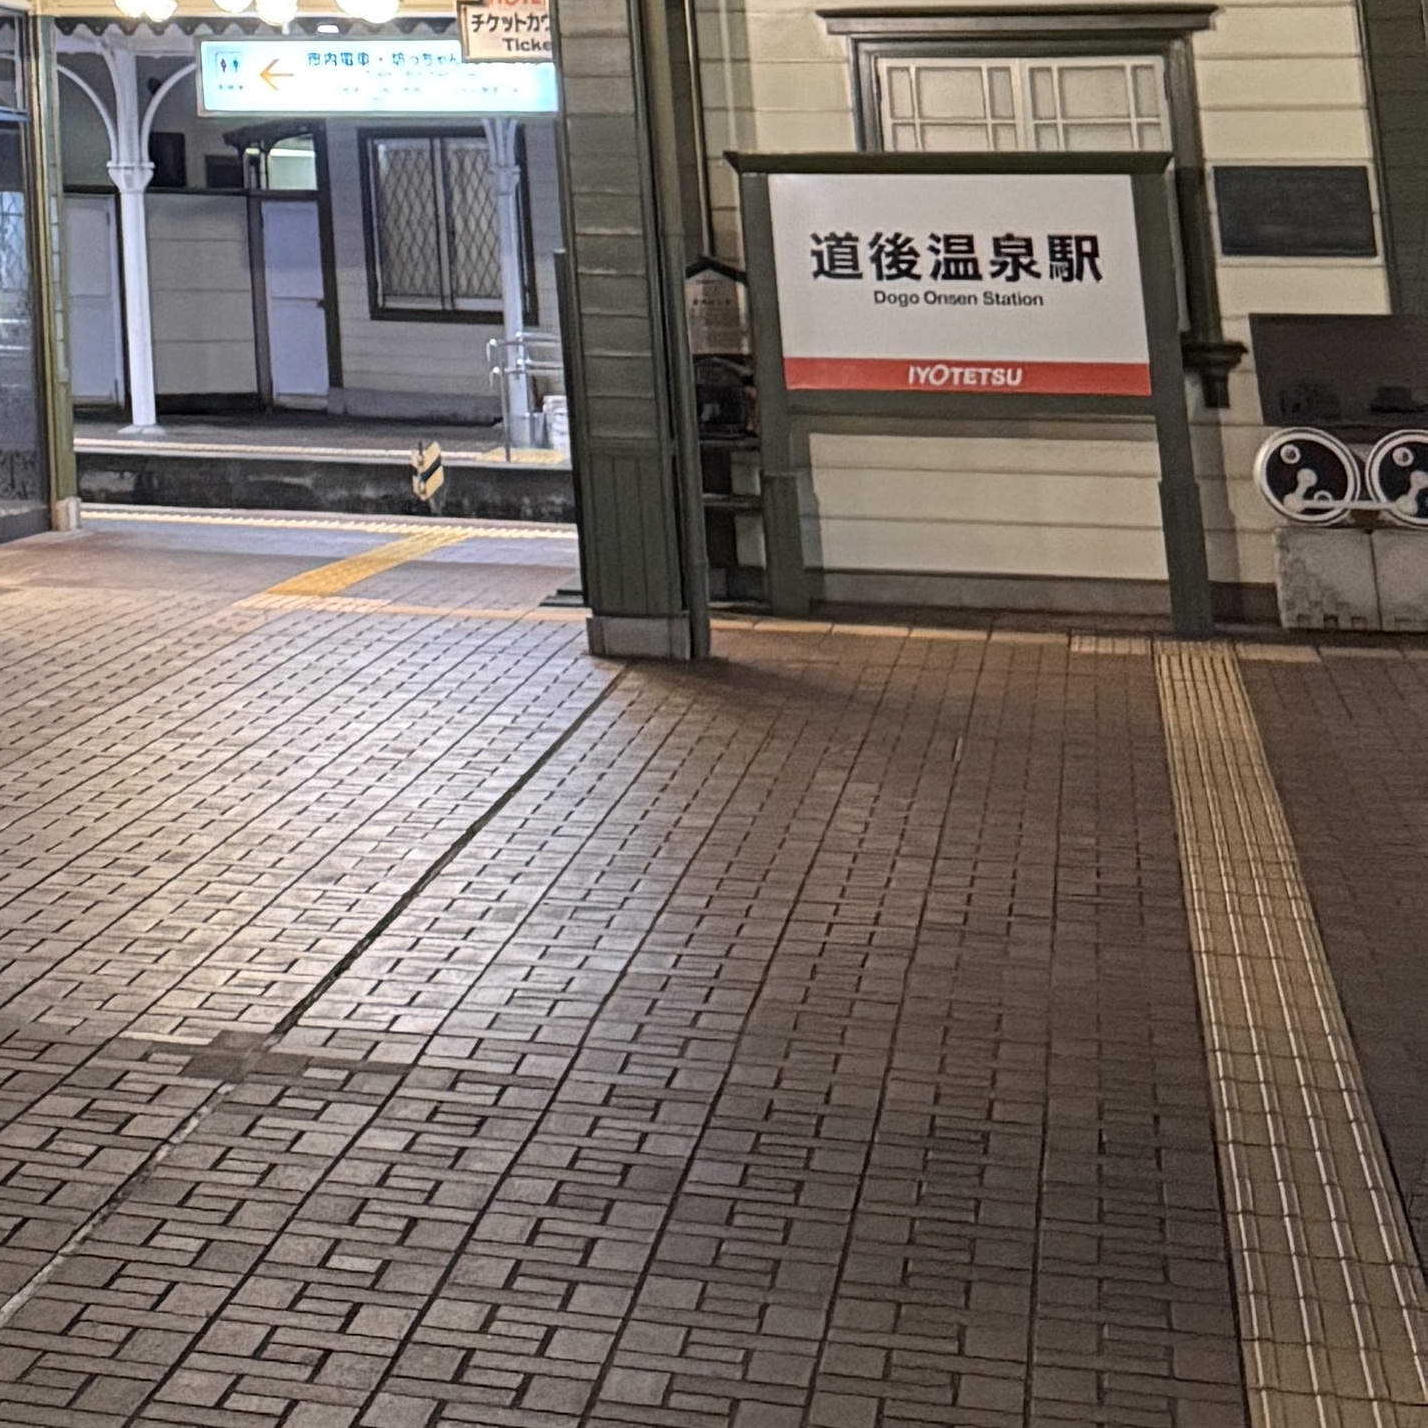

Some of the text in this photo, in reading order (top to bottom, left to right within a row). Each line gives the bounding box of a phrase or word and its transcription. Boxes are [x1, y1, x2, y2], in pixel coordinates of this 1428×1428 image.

[810, 232, 1103, 284] 道後温泉駅
[874, 290, 1045, 308] Dogo Onsen Station
[908, 364, 1023, 386] IYOTETSU
